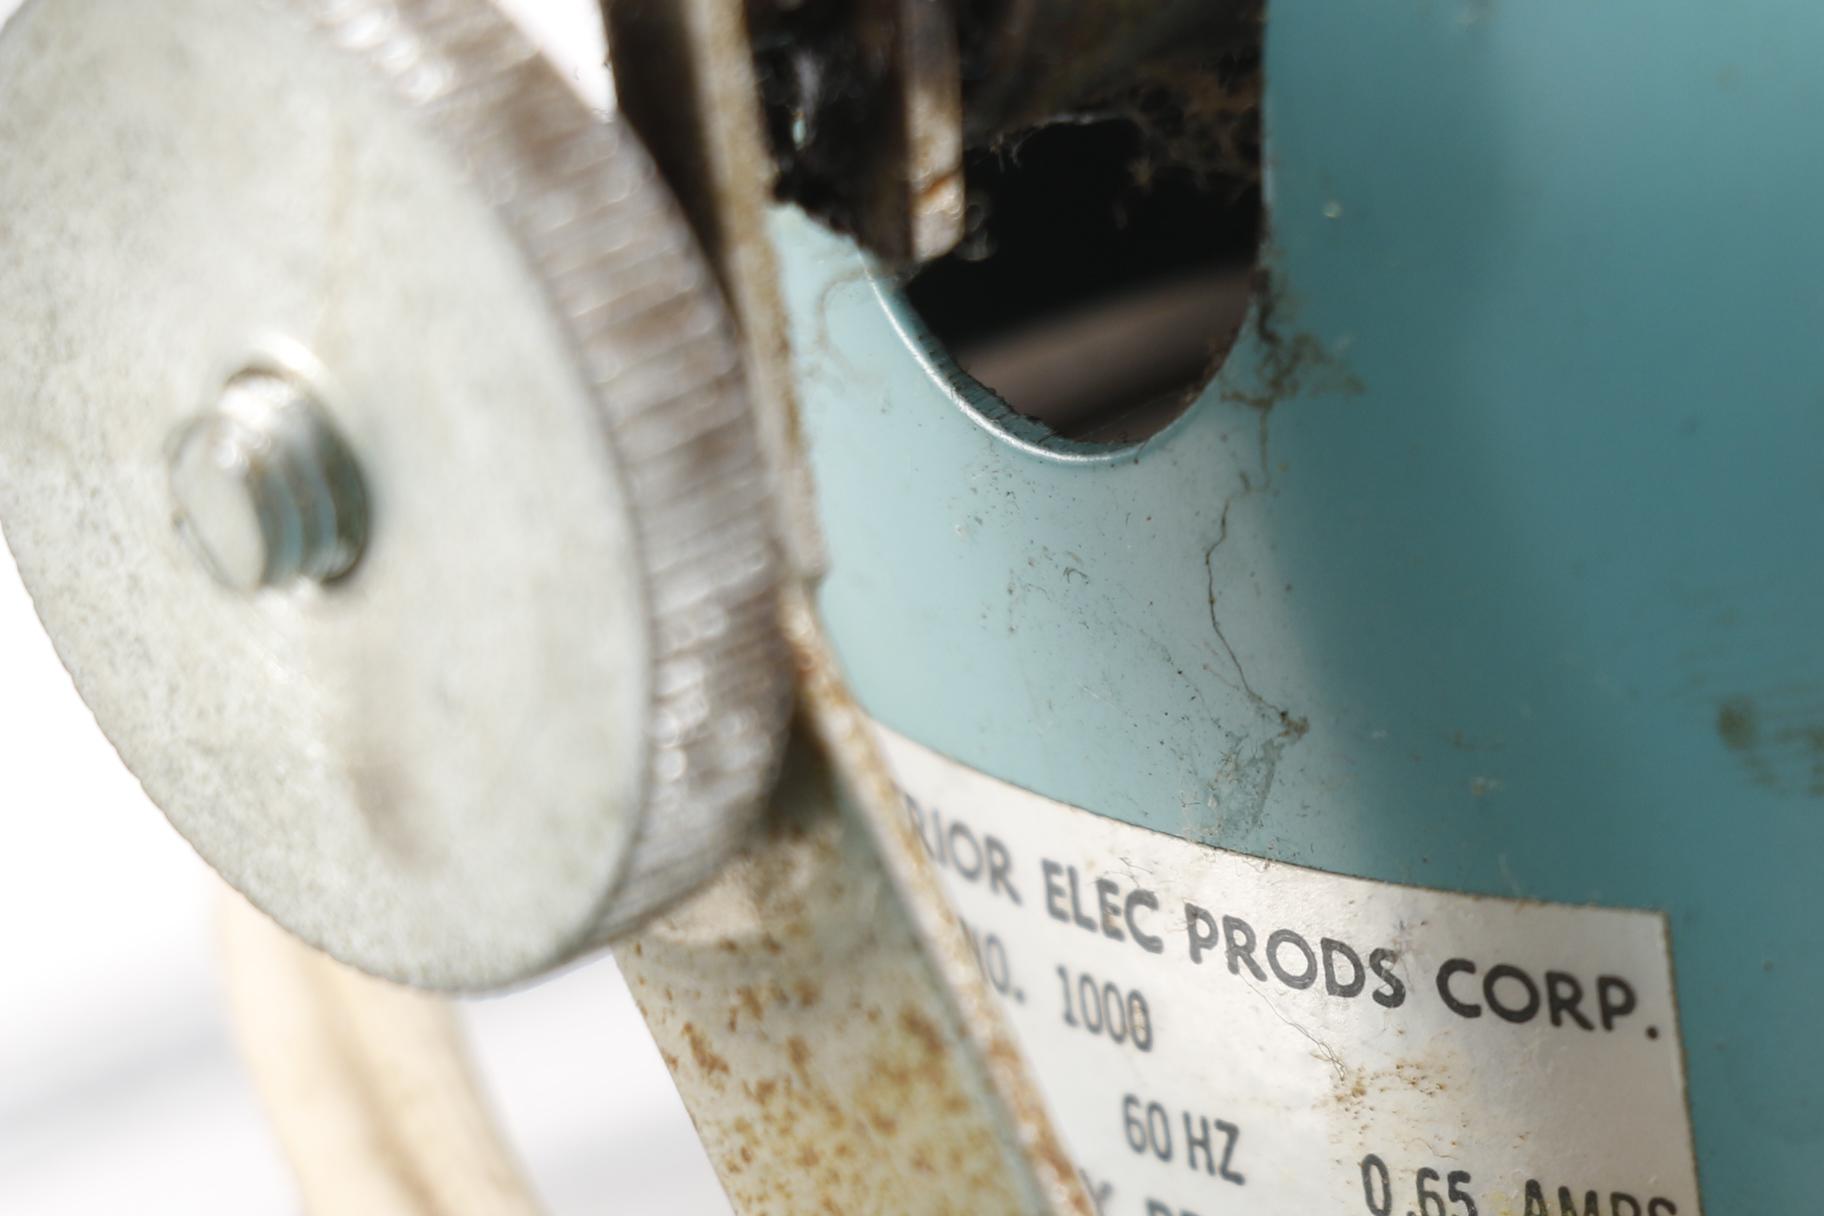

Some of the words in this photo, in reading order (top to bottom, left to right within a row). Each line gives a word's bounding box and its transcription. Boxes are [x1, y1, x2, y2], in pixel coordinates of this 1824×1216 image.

[1041, 857, 1164, 955] ELEC
[1184, 902, 1407, 1009] PRODS
[1435, 957, 1660, 1041] CORP.
[1056, 964, 1154, 1052] 1000
[1122, 1093, 1174, 1162] 60
[1182, 1110, 1246, 1187] HZ
